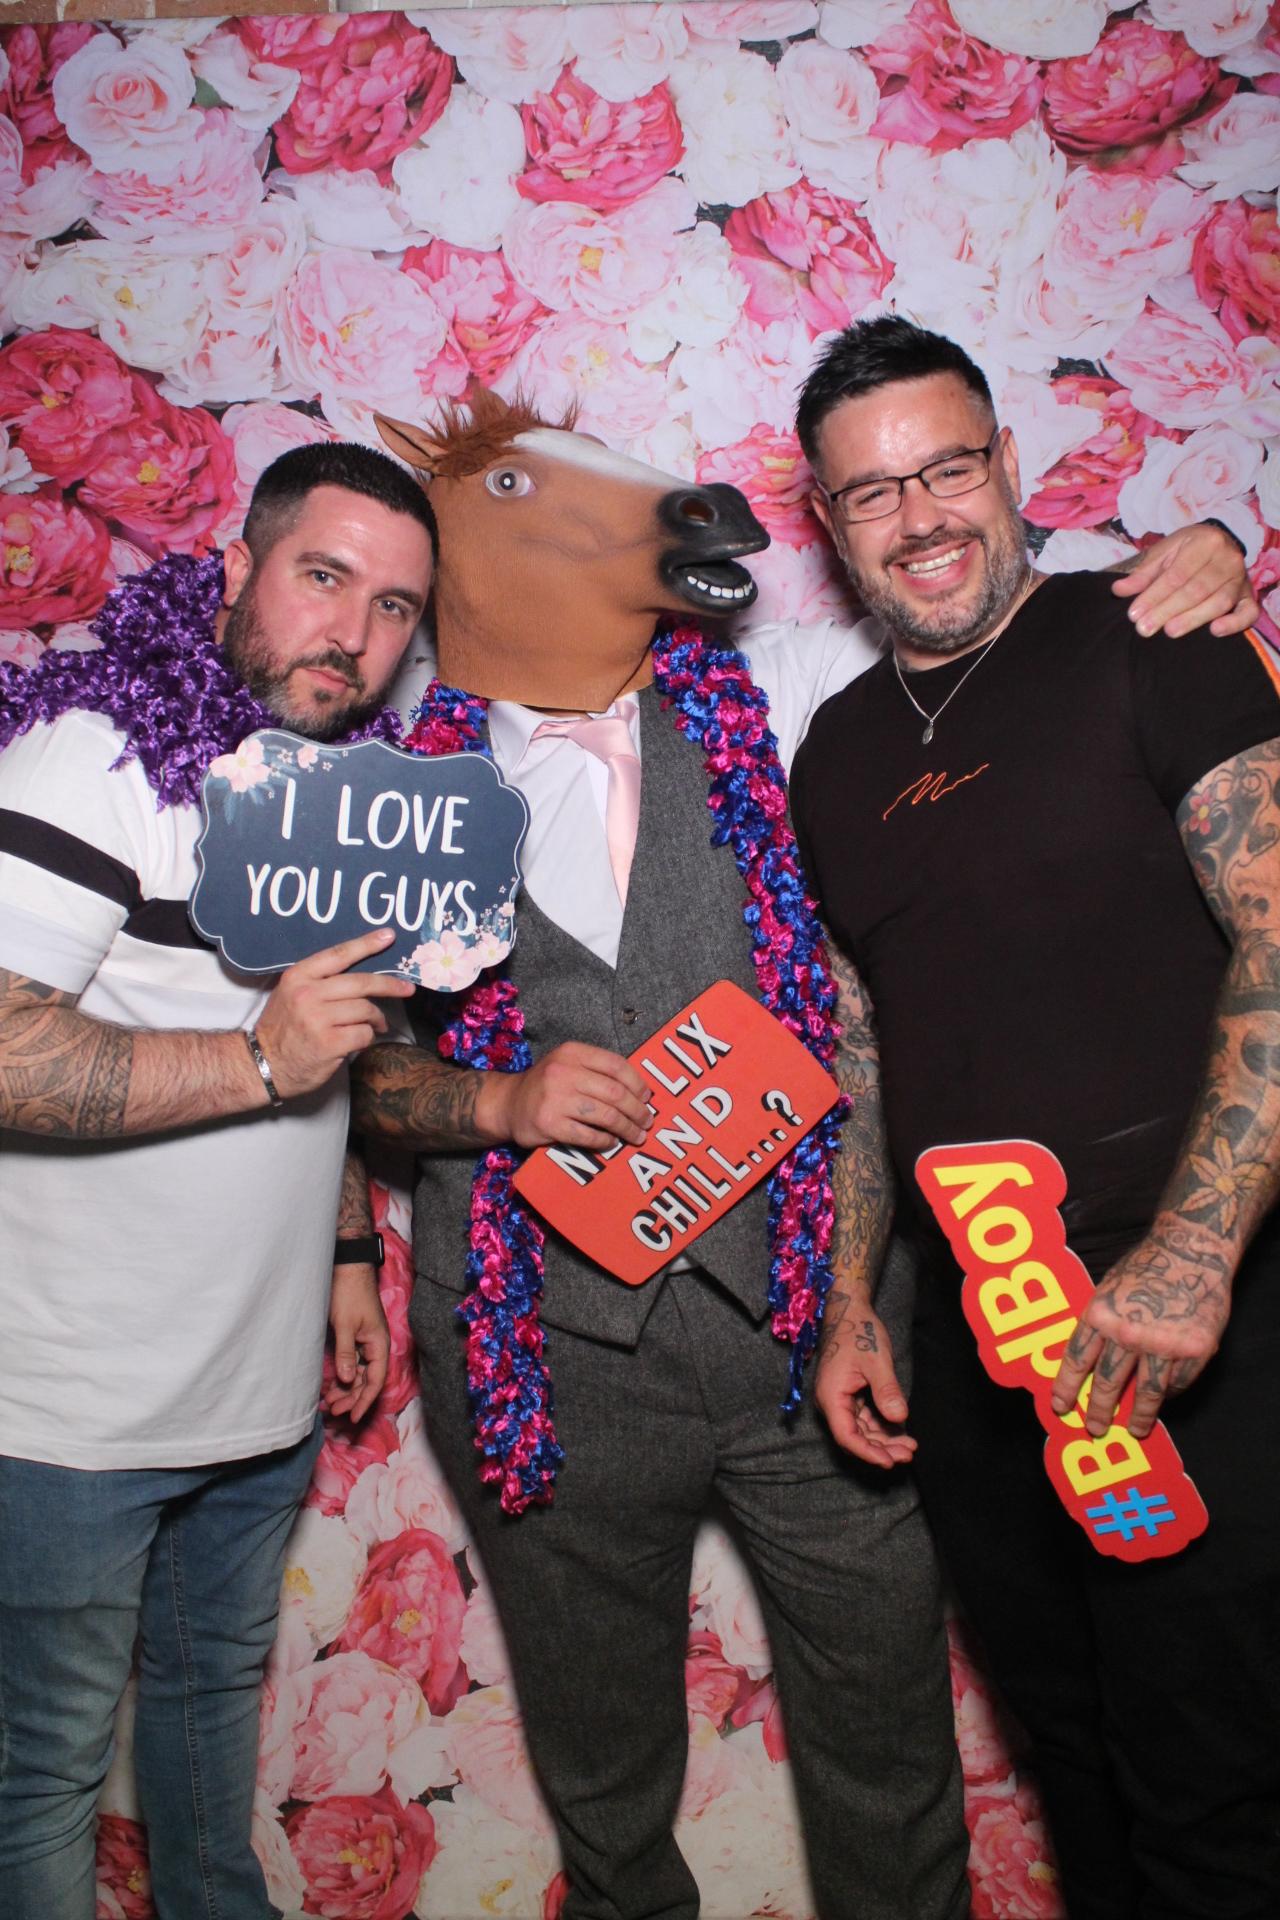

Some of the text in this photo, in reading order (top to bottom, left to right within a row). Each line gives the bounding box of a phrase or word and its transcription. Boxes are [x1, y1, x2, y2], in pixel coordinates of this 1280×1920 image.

[281, 777, 470, 854] I LOVE
[246, 863, 476, 937] YOU GUYS
[545, 1012, 732, 1186] NLIX
[627, 1086, 733, 1193] AND
[631, 1089, 803, 1252] CHILL...?
